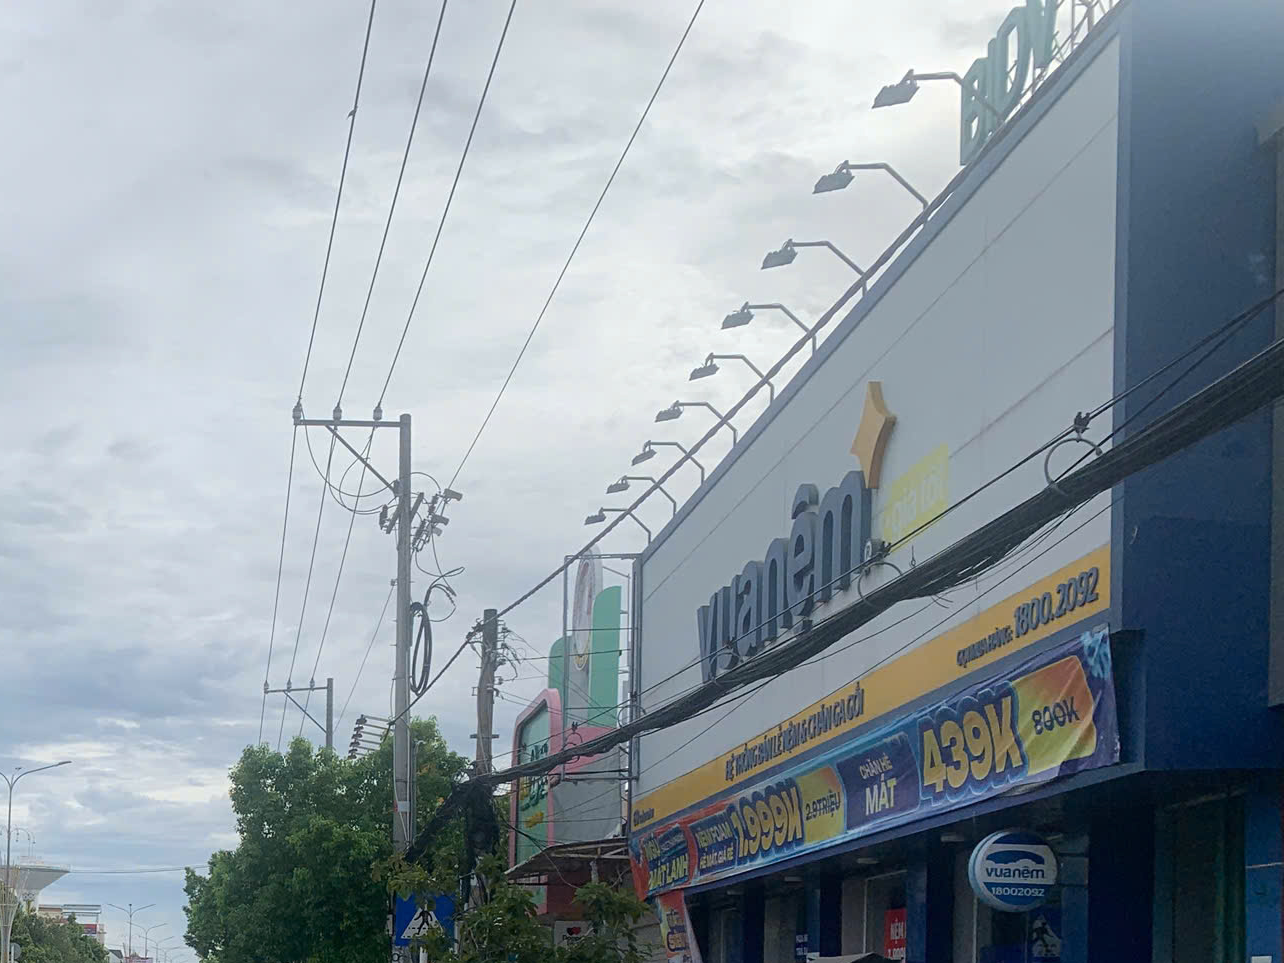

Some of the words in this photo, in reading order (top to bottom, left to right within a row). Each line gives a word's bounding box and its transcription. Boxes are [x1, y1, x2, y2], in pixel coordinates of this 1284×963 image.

[1013, 567, 1099, 639] 1800.2092
[922, 696, 1024, 794] 439K
[730, 787, 803, 857] 1.999K
[865, 775, 897, 816] MÁT
[991, 886, 1044, 897] 18002092
